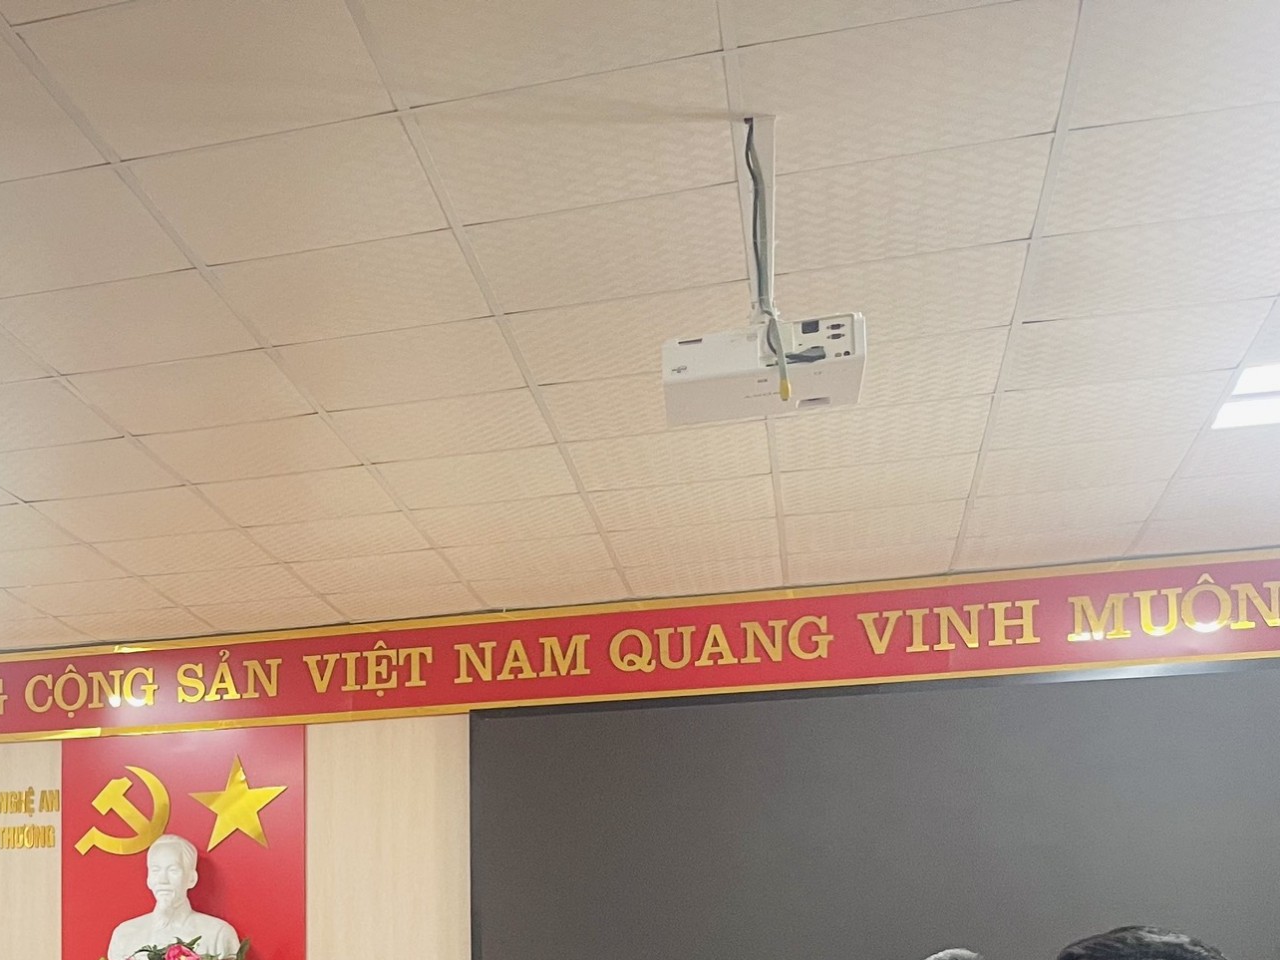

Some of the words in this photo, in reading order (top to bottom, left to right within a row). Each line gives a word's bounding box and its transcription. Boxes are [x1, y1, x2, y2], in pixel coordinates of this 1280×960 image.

[24, 663, 159, 719] CỘNG
[176, 649, 283, 704] SẢN
[302, 639, 433, 698] VIỆT
[453, 633, 591, 685] NAM
[609, 614, 835, 673] QUANG
[856, 599, 1041, 655] VINH
[1067, 572, 1280, 642] MUÔN
[39, 789, 61, 813] AN
